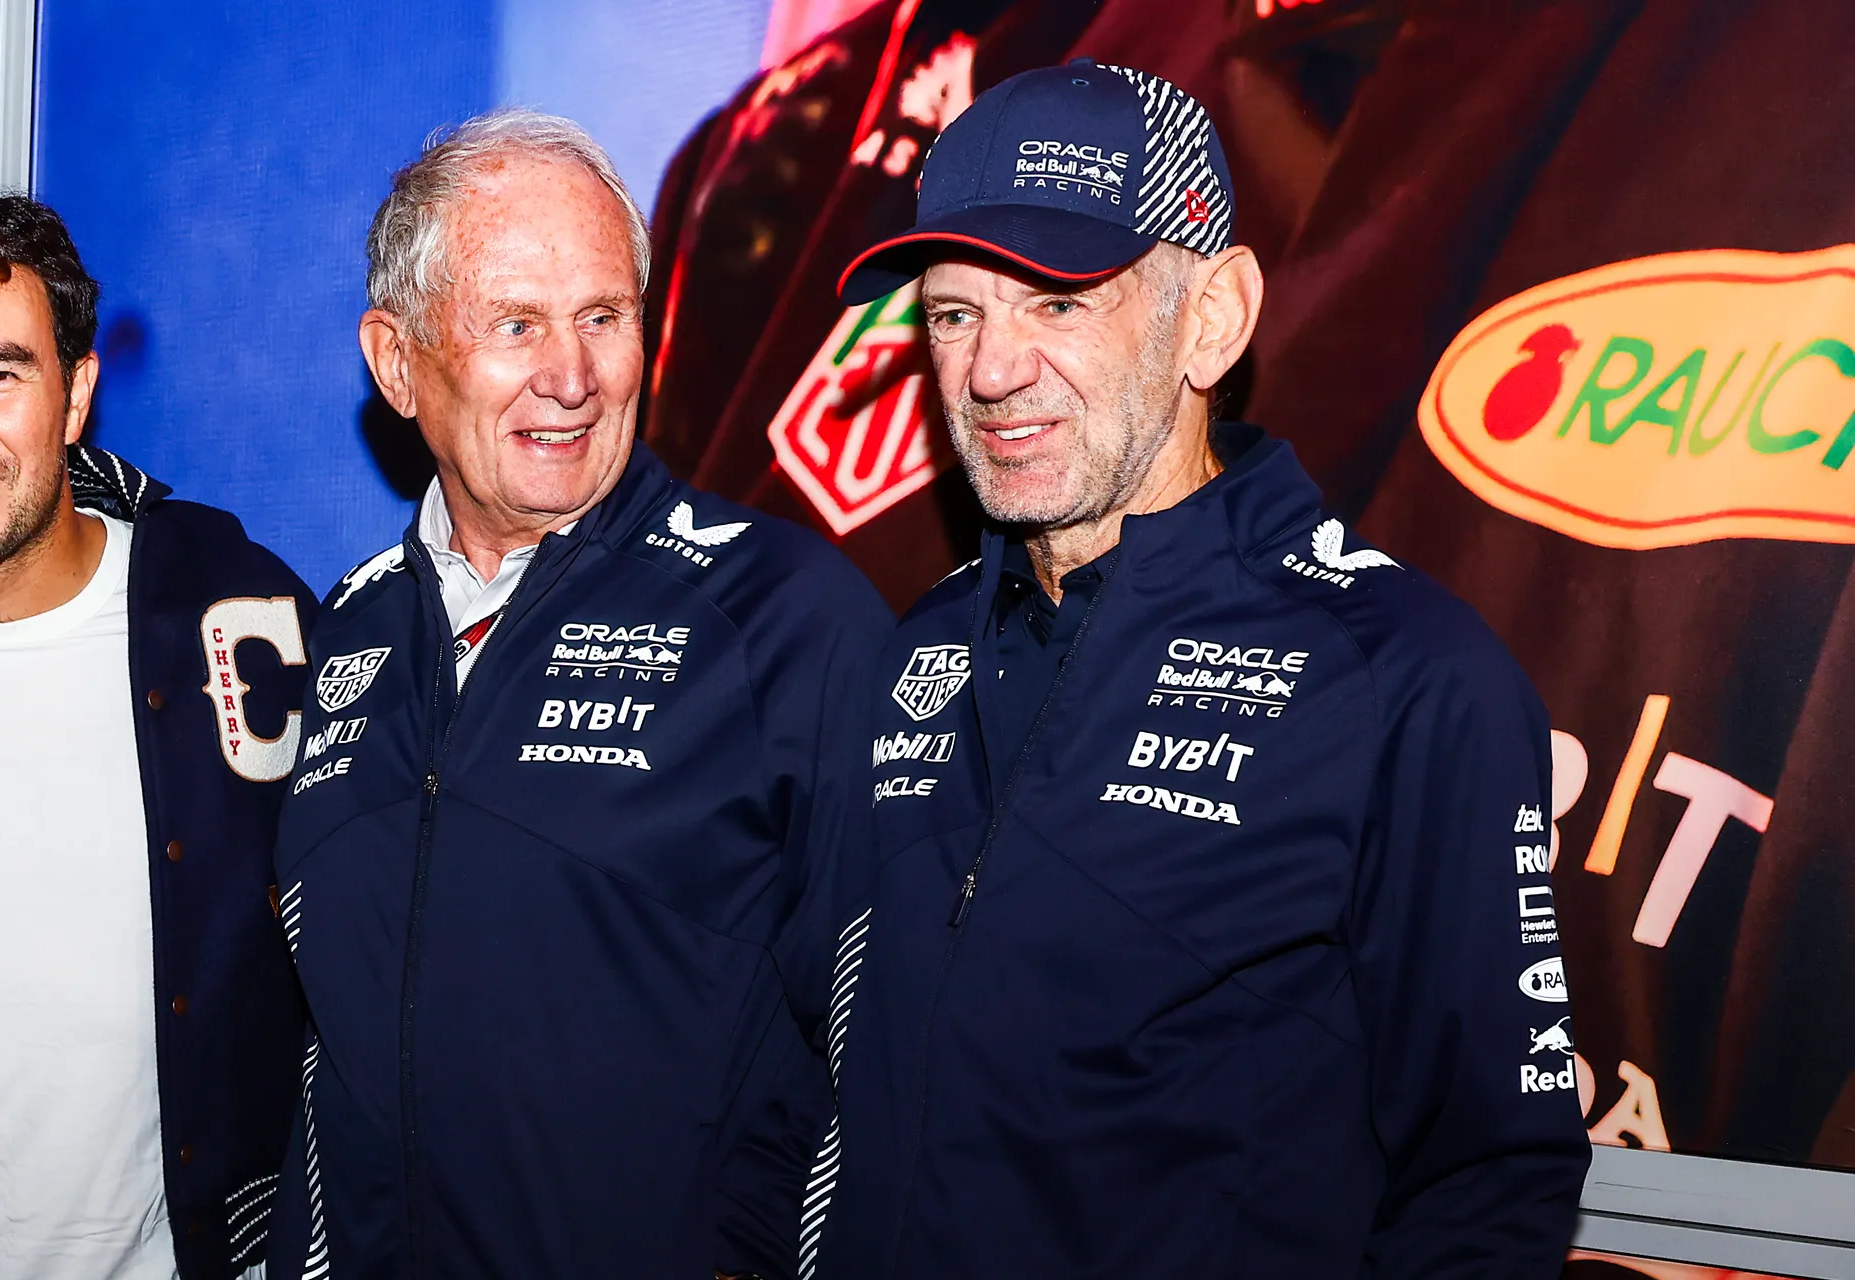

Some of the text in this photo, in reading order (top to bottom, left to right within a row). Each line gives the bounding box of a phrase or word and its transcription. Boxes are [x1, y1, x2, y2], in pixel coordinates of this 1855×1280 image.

[1015, 157, 1077, 176] Red Bull
[1019, 139, 1129, 169] ORACLE
[1013, 179, 1121, 206] RACING
[645, 533, 714, 568] CASTORE
[1281, 553, 1355, 590] CASTORE
[560, 623, 691, 645] ORACLE
[332, 652, 382, 677] TAG
[552, 643, 624, 661] Red Bull
[917, 650, 970, 675] TAG
[1168, 638, 1310, 673] ORACLE
[200, 596, 306, 782] C
[318, 674, 371, 707] HEUER
[545, 666, 677, 682] RACING
[1157, 664, 1234, 689] Red Bull
[213, 628, 241, 756] CHERRY
[899, 677, 961, 716] HEUER
[1147, 694, 1284, 719] RACING
[537, 696, 655, 732] BYBIT
[518, 744, 651, 771] HONDA
[872, 731, 932, 769] Mobil
[1127, 731, 1254, 782] BYBIT
[293, 758, 352, 795] ORACLE
[873, 777, 938, 804] RACLE
[1100, 783, 1241, 826] HONDA
[1520, 1060, 1576, 1094] Red
